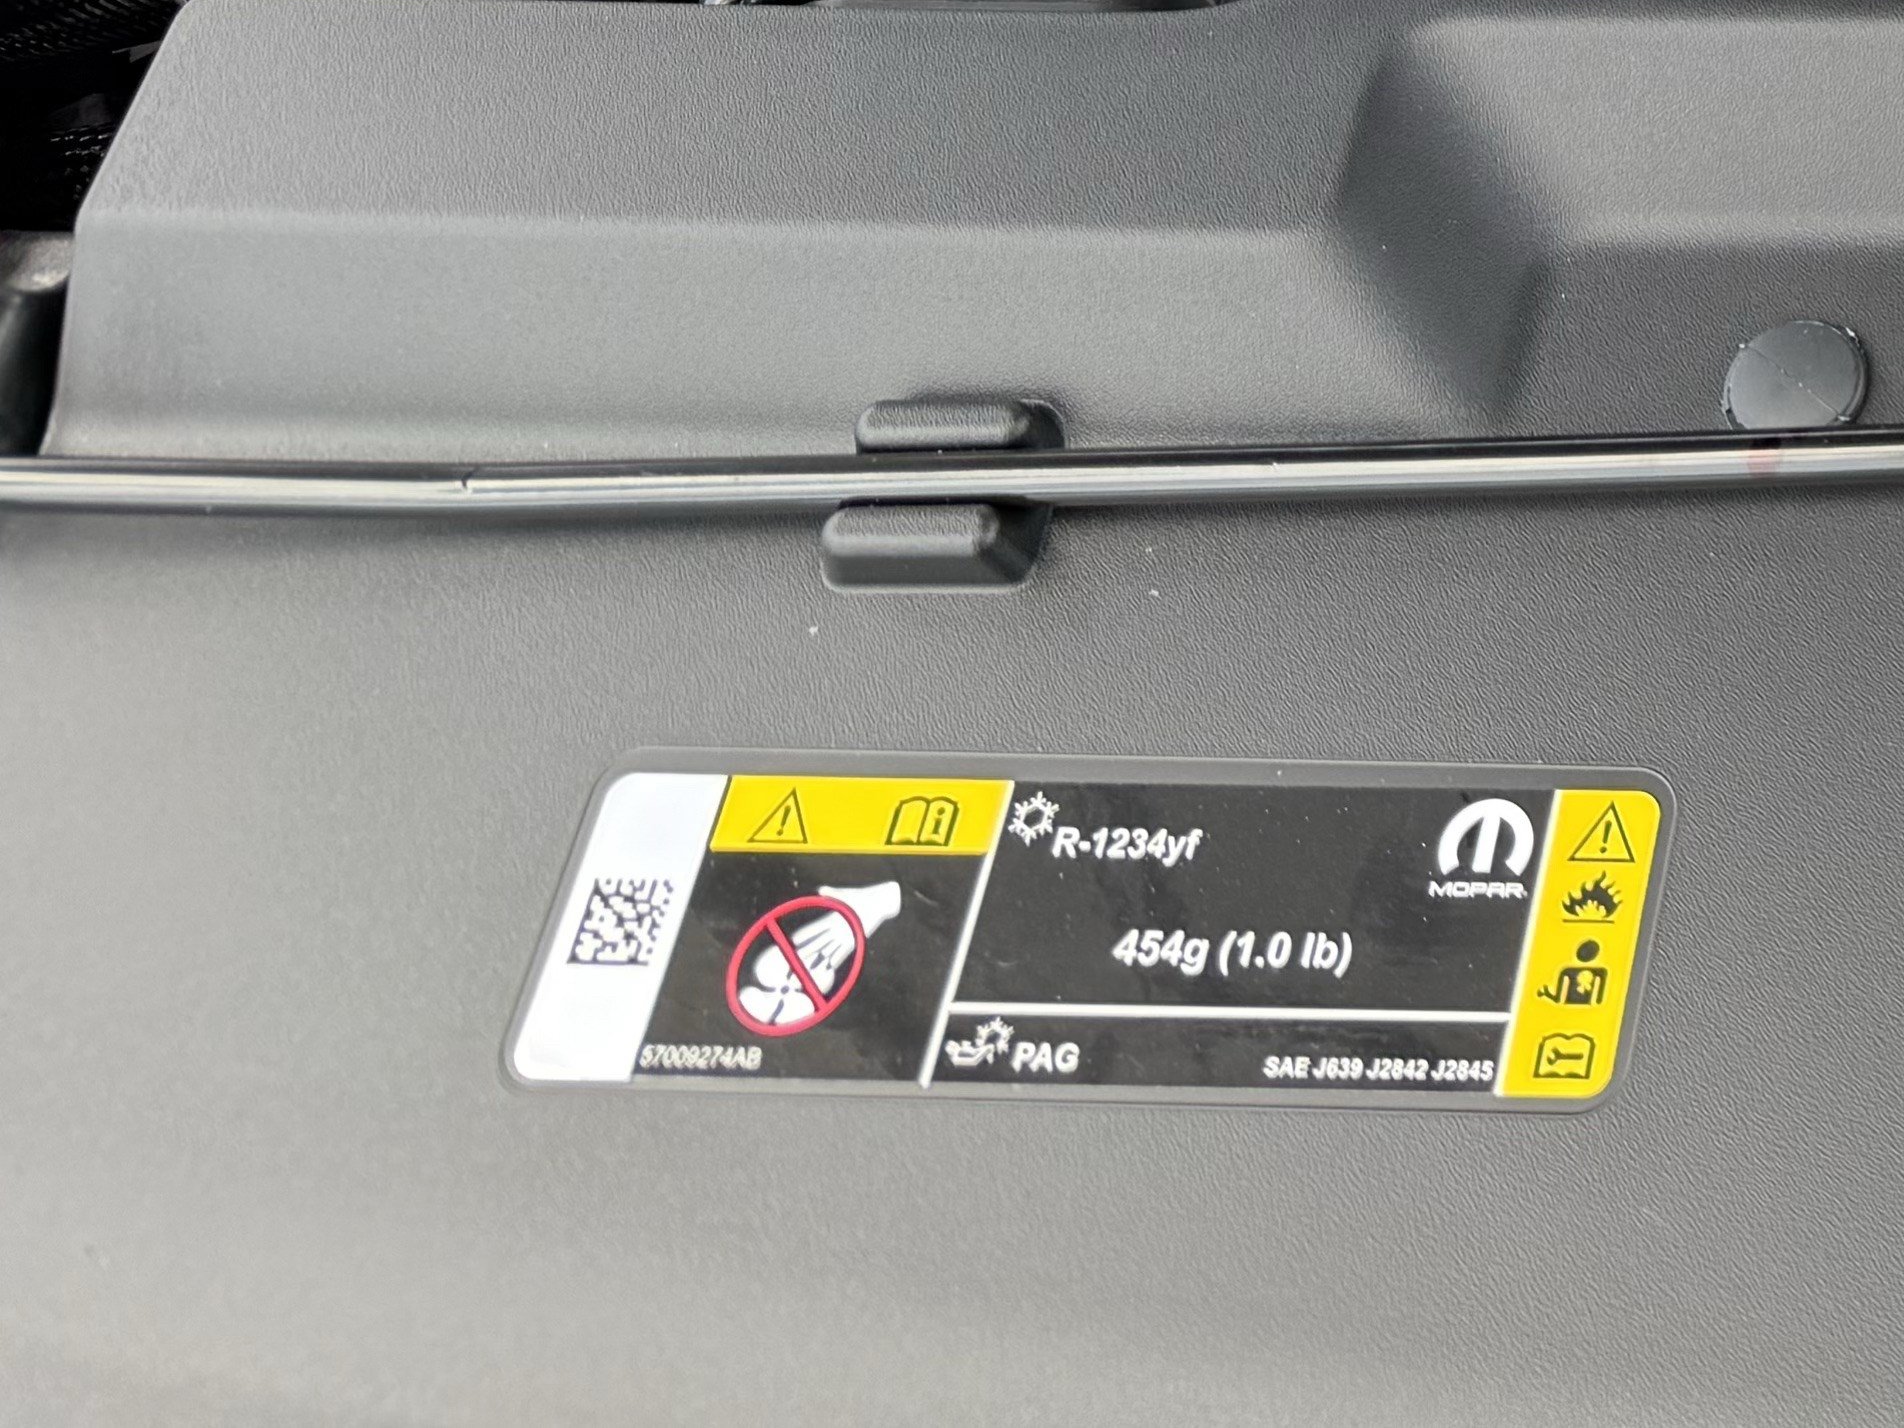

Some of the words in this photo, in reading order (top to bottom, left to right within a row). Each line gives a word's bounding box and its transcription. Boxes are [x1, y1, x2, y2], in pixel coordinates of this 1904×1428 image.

[1051, 827, 1205, 869] R-1234yf
[1427, 880, 1529, 899] MOPAR
[1111, 928, 1210, 976] 454g
[1219, 930, 1294, 978] (1.0
[1300, 931, 1355, 979] lb)
[1011, 1040, 1081, 1074] PAG
[1261, 1056, 1310, 1077] SAE
[1312, 1057, 1363, 1079] J639
[1366, 1058, 1427, 1081] J2842
[1429, 1060, 1495, 1082] J2845
